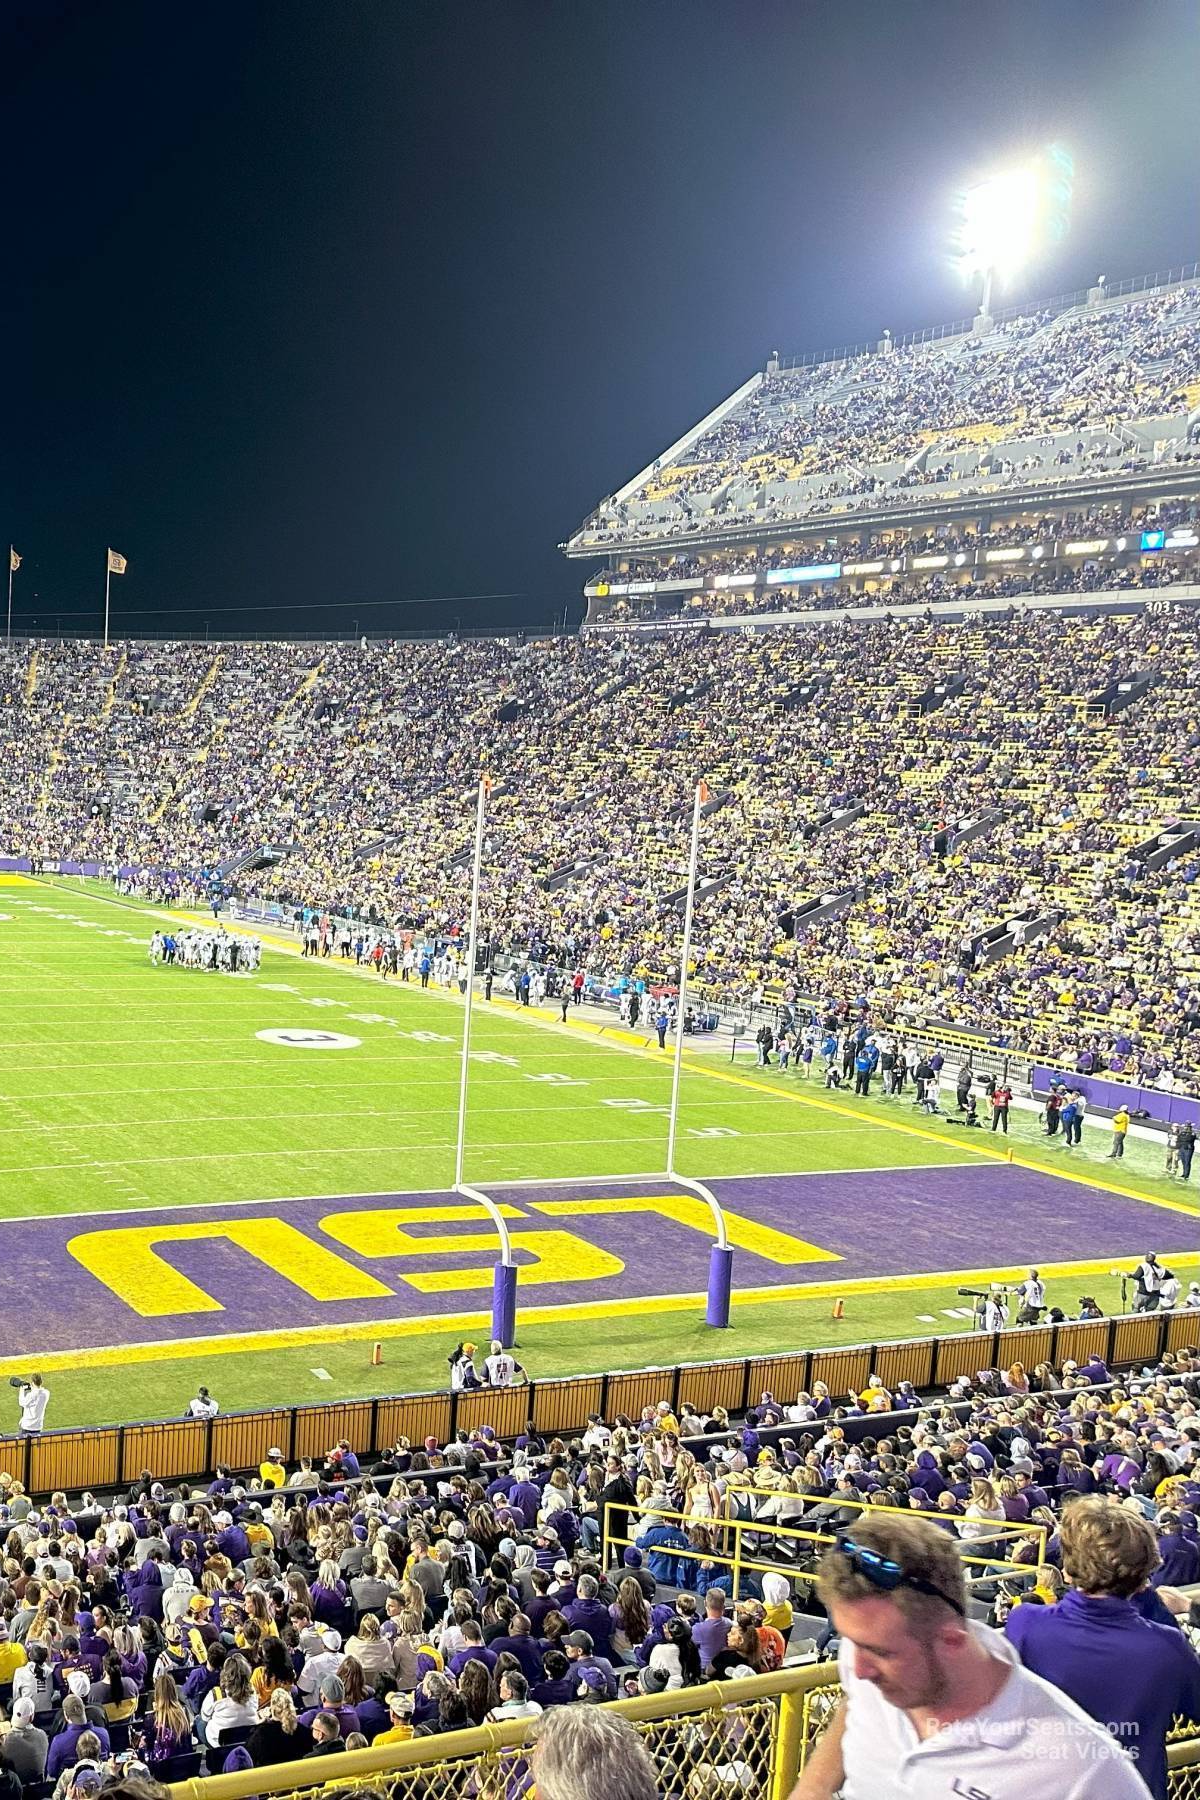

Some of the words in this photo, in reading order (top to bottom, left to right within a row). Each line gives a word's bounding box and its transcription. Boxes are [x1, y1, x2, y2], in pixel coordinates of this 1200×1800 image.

[1144, 601, 1170, 615] 303
[740, 626, 756, 635] 300
[687, 1127, 742, 1137] 5
[66, 1195, 847, 1317] LSU
